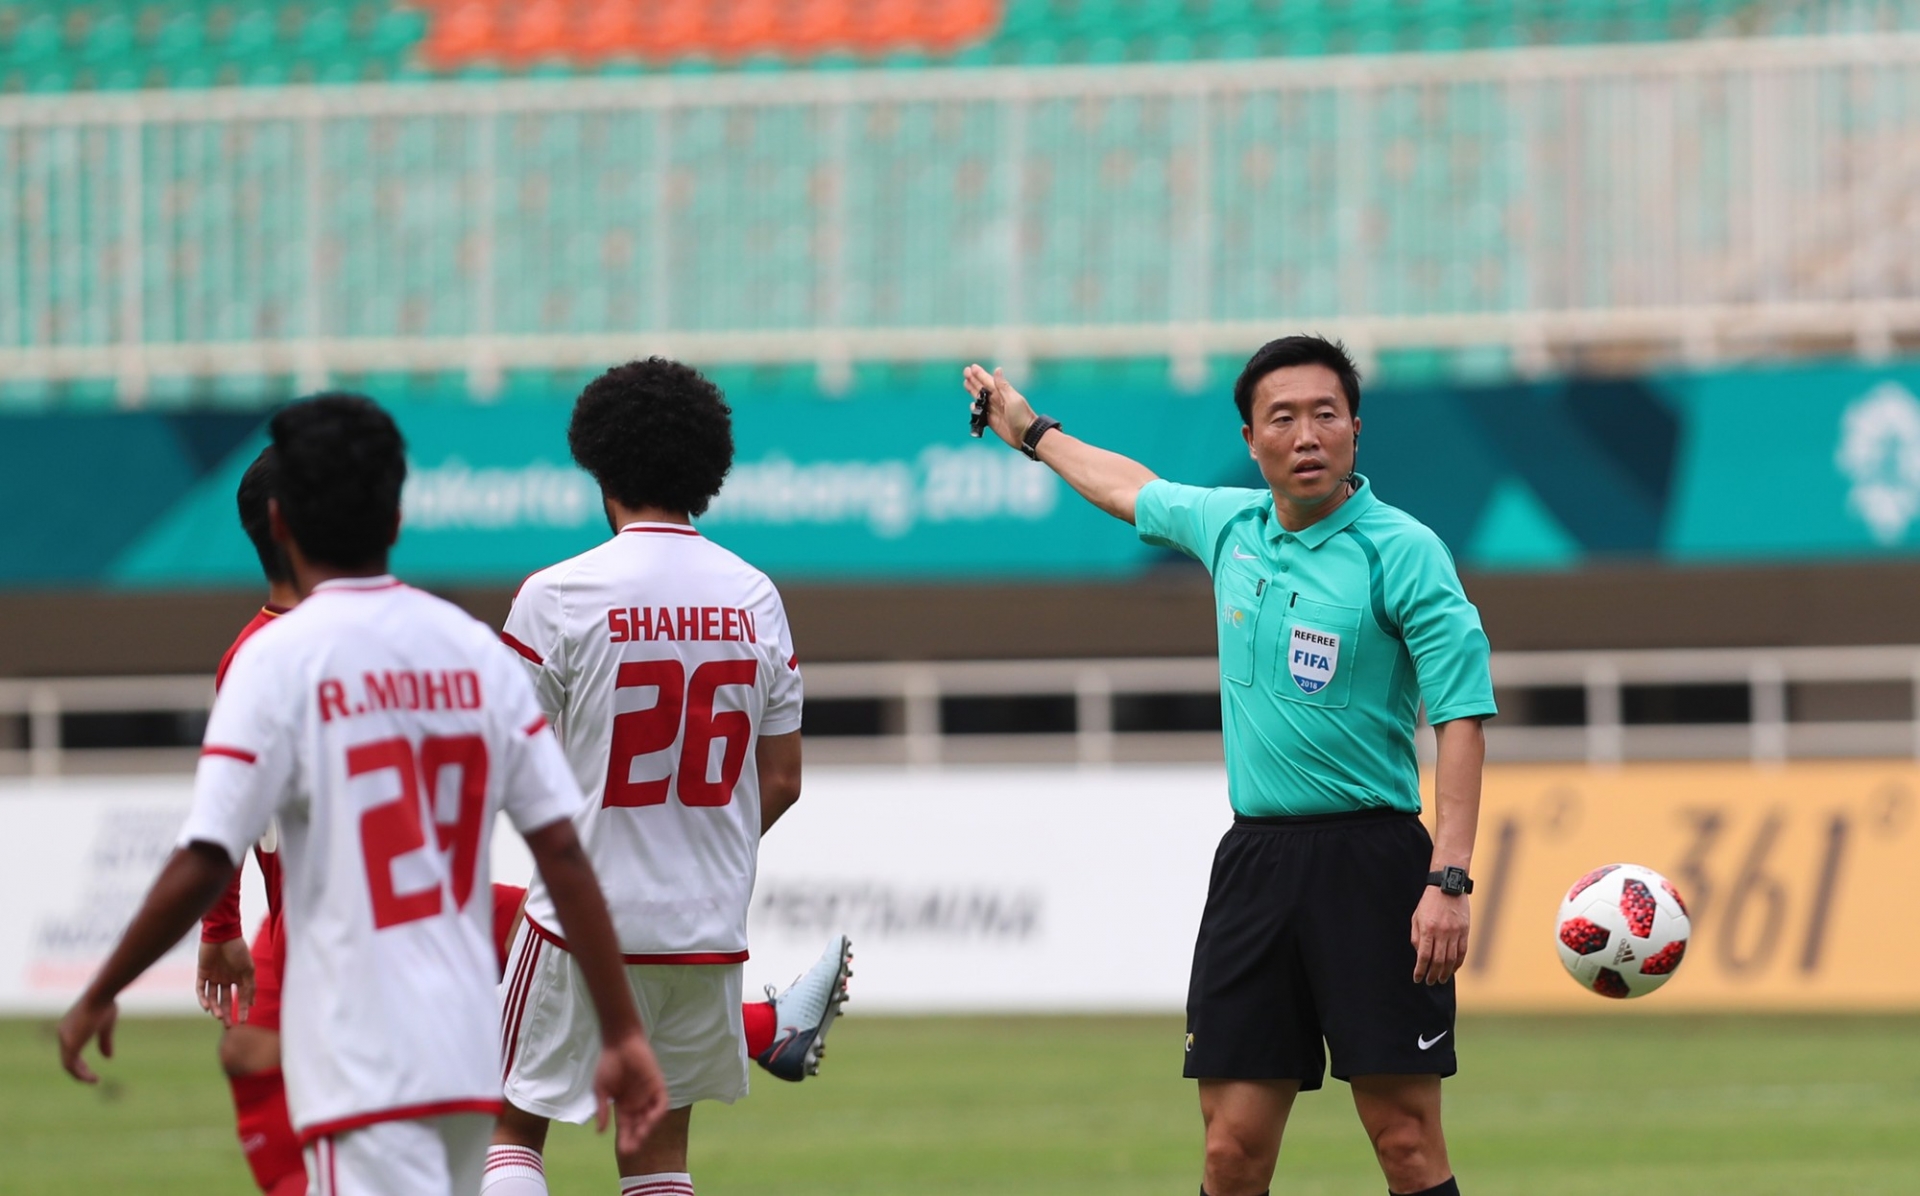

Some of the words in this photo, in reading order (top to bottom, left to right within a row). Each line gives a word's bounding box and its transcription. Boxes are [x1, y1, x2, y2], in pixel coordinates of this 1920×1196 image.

[608, 606, 757, 644] SHAHEEN
[1294, 629, 1336, 648] REFEREE
[1293, 649, 1330, 672] FIFA
[317, 669, 483, 723] R.MOHD
[1300, 679, 1318, 690] 2018
[602, 659, 758, 809] 26
[346, 735, 489, 930] 29
